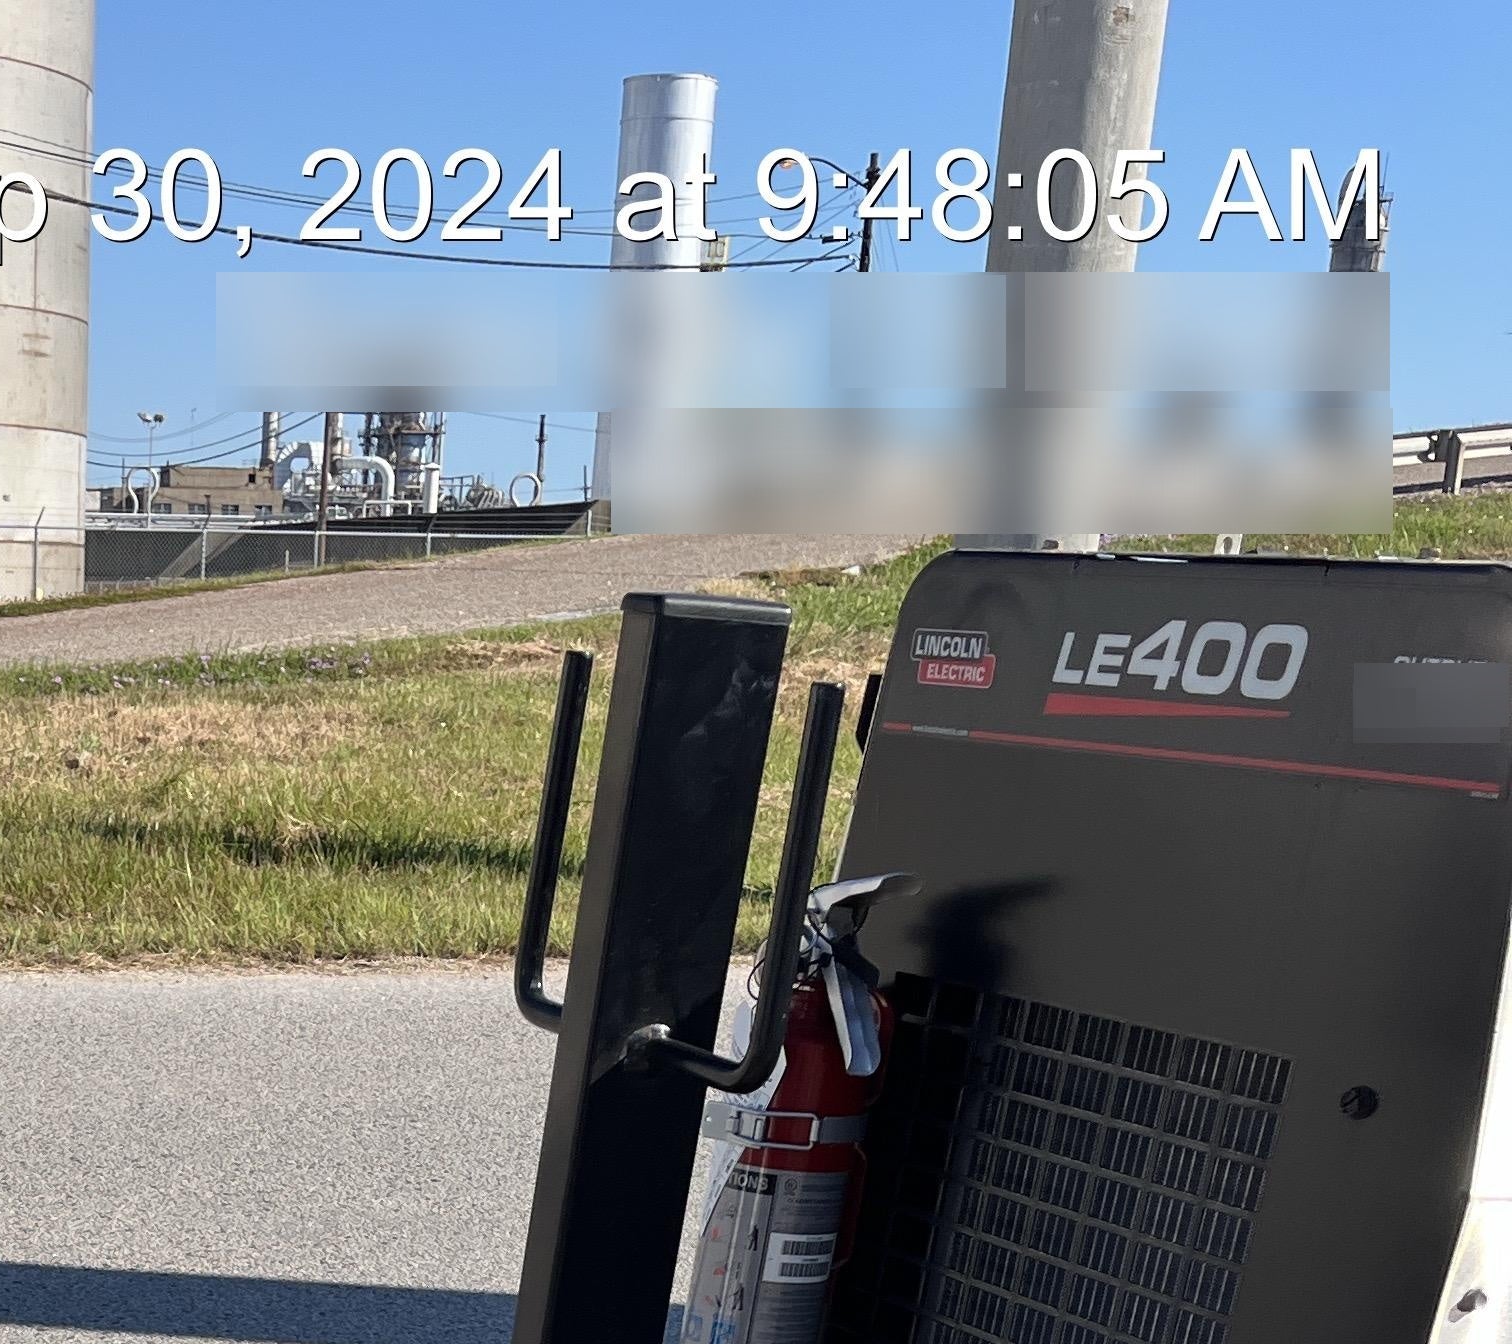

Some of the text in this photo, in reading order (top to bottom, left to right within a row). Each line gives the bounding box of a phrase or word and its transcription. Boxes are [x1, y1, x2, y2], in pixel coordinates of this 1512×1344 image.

[915, 634, 983, 659] LINCOLN
[1052, 619, 1309, 700] LE400
[926, 663, 986, 682] ELECTRIC
